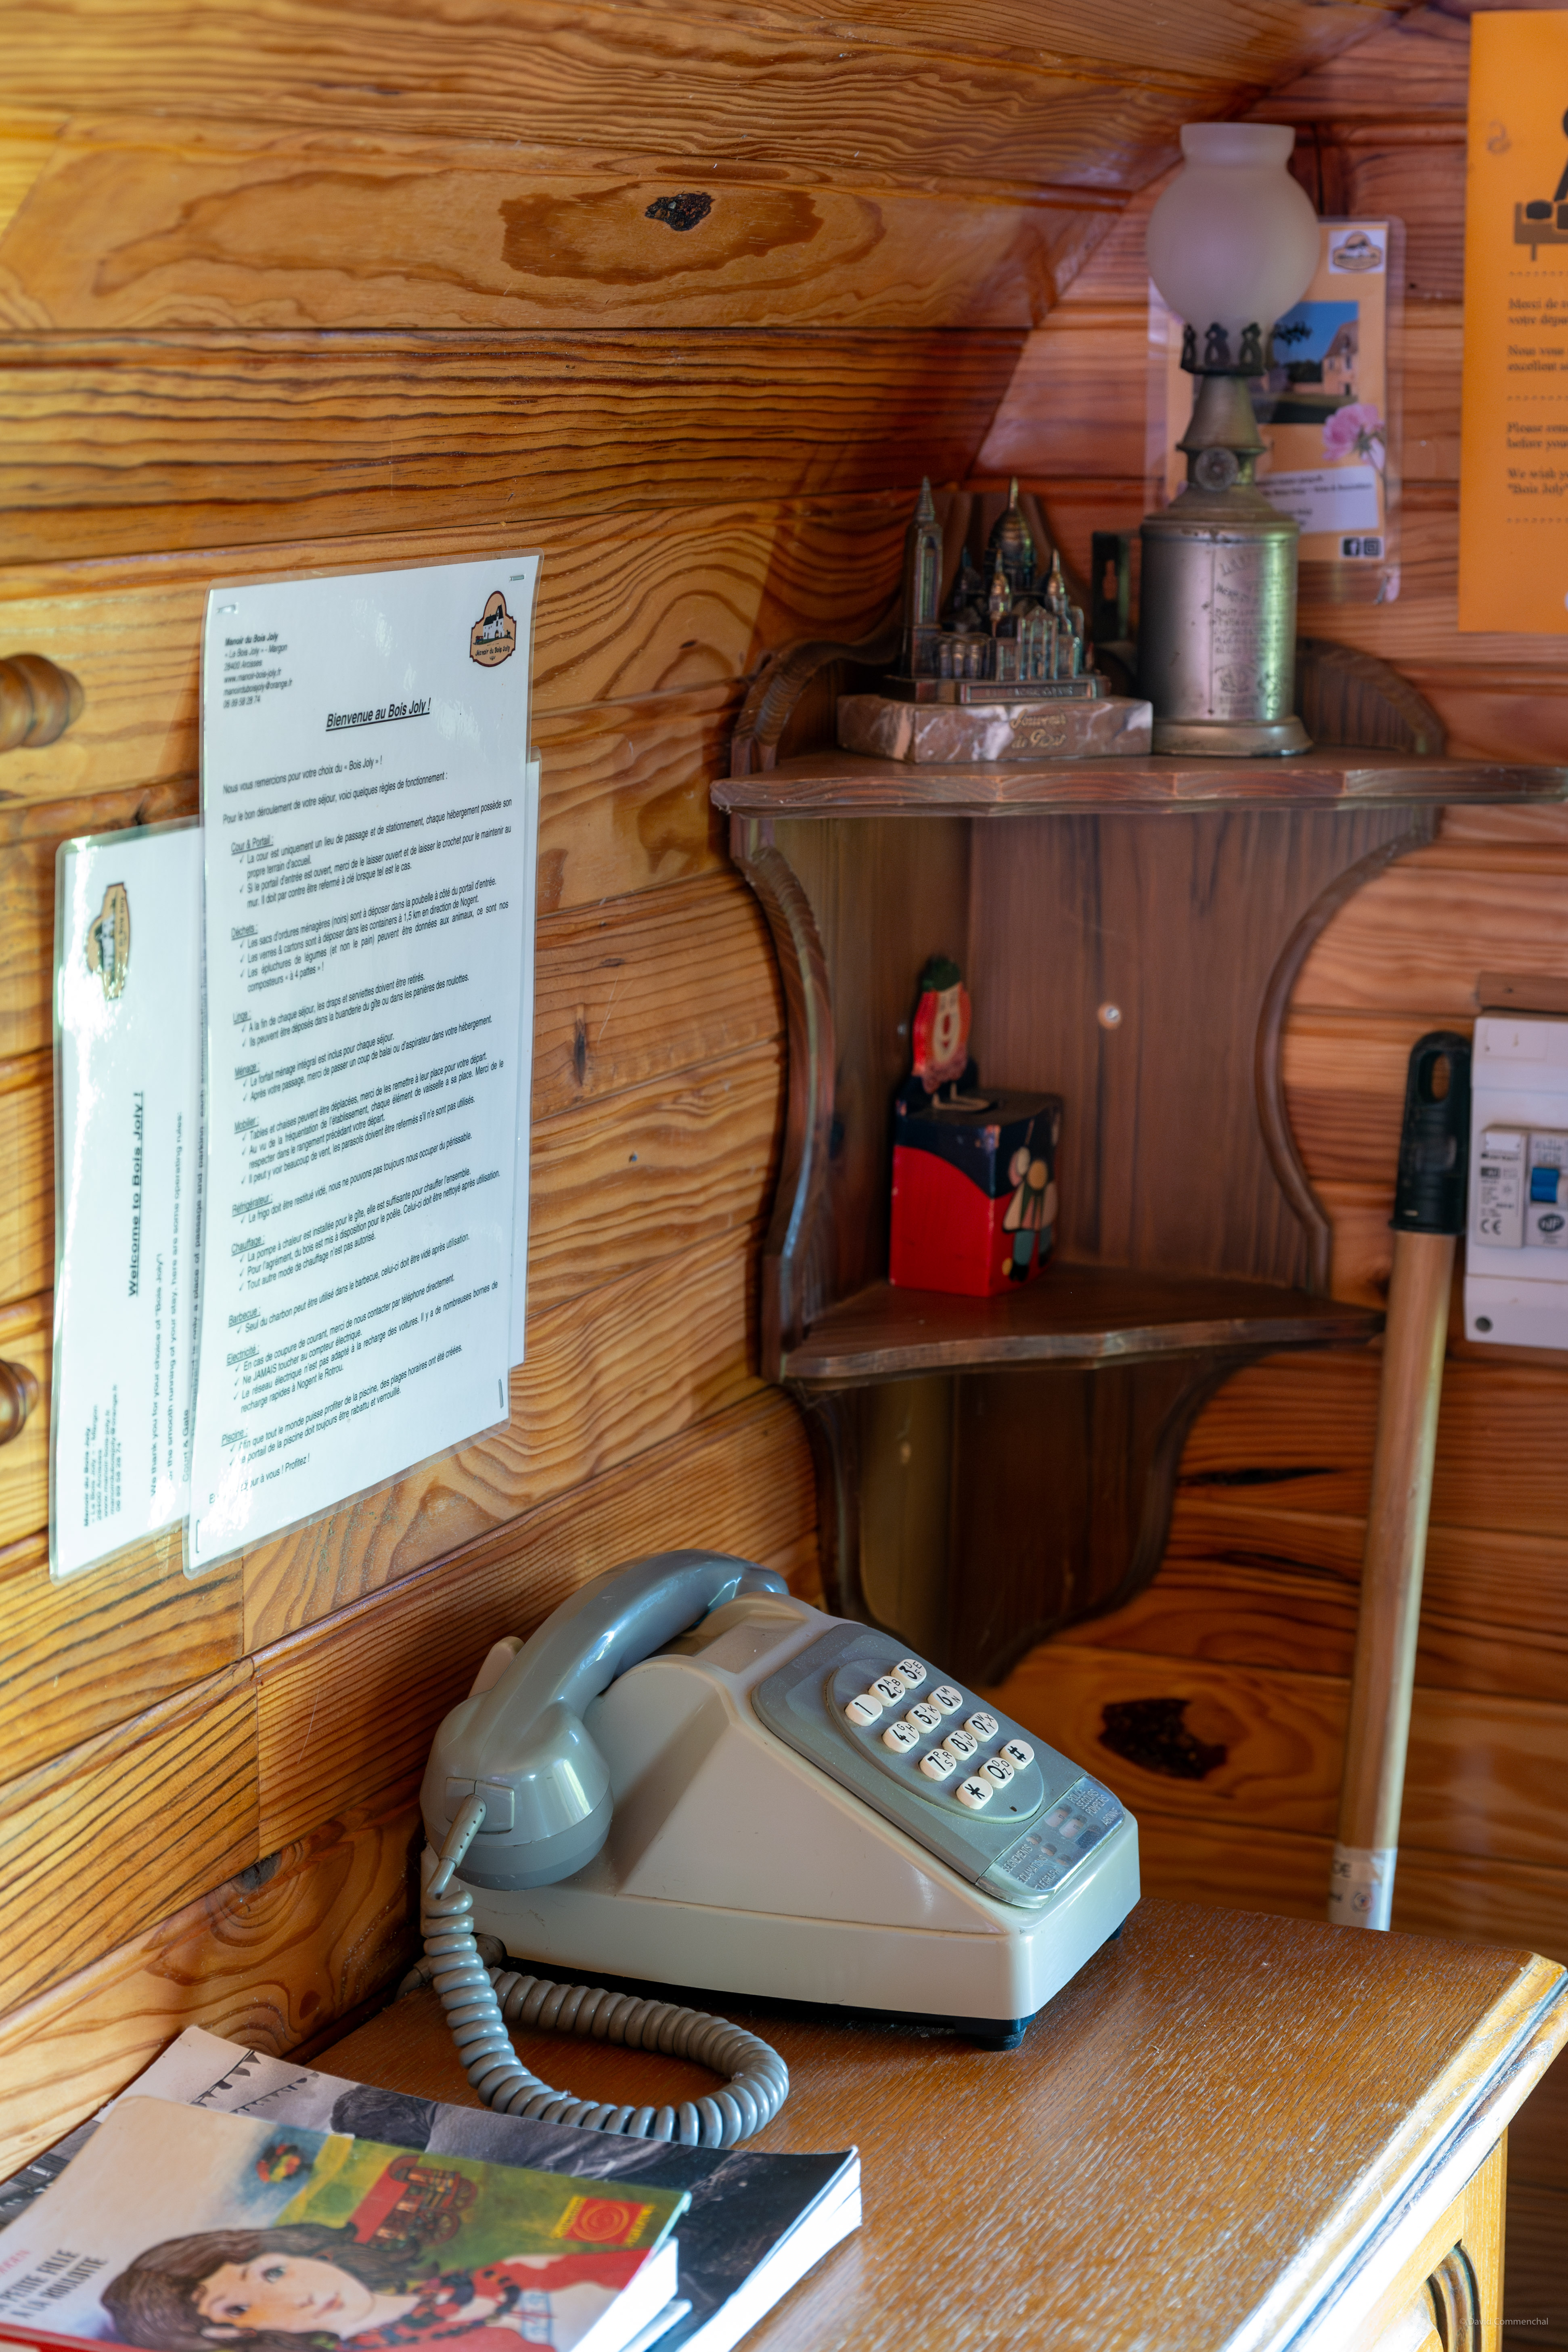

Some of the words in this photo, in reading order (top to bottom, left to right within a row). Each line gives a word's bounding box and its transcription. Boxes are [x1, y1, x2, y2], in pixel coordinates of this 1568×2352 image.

[225, 637, 244, 646] Manoir
[253, 634, 266, 643] Bois
[266, 632, 278, 642] Joly
[327, 710, 373, 727] Bienvenue
[375, 708, 386, 720] au
[388, 702, 407, 718] Bois
[407, 699, 427, 718] Joly
[223, 784, 238, 794] Nous
[240, 781, 253, 790] vous
[255, 775, 287, 787] remercions
[288, 772, 301, 783] pour
[302, 769, 317, 779] votre
[318, 765, 333, 776] choix
[335, 763, 342, 773] du
[349, 760, 362, 770] Bois
[362, 758, 374, 769] Joly
[223, 814, 236, 823] Pour
[238, 812, 243, 821] le
[244, 811, 255, 820] bon
[257, 802, 292, 817] déroulement
[293, 800, 301, 809] de
[302, 798, 316, 807] votre
[318, 794, 337, 806] séjour,
[339, 789, 352, 800] voici
[353, 786, 378, 800] quelques
[379, 782, 396, 794] règles
[397, 779, 404, 790] de
[405, 772, 444, 787] fonctionnement
[247, 868, 265, 879] propre
[267, 863, 285, 873] terrain
[286, 855, 311, 869] d'accueil.
[248, 954, 258, 963] Les
[260, 949, 276, 959] verres
[284, 941, 304, 953] cartons
[305, 936, 316, 947] sont
[322, 930, 344, 943] déposer
[345, 926, 359, 936] dans
[360, 924, 368, 932] les
[369, 917, 397, 930] containers
[404, 911, 412, 922] 1,5
[413, 910, 421, 919] km
[422, 909, 429, 917] en
[430, 902, 452, 915] direction
[452, 899, 459, 909] de
[460, 894, 479, 907] Nogent.
[133, 1104, 142, 1141] Joly
[132, 1148, 140, 1186] Bois
[248, 1208, 257, 1223] Le
[257, 1204, 270, 1220] frigo
[271, 1202, 281, 1214] doit
[283, 1200, 293, 1210] être
[294, 1190, 314, 1205] restitué
[315, 1185, 327, 1197] vidé,
[329, 1181, 341, 1192] nous
[342, 1178, 349, 1187] ne
[350, 1170, 372, 1186] pouvons
[373, 1166, 383, 1177] pas
[384, 1158, 404, 1171] toujours
[406, 1153, 418, 1163] nous
[419, 1145, 438, 1158] occuper
[439, 1141, 445, 1150] du
[446, 1132, 472, 1150] périssable.
[132, 1193, 139, 1209] to
[128, 1217, 139, 1296] Welcome
[228, 1309, 257, 1326] Barbecue
[243, 1376, 251, 1384] Ne
[253, 1363, 276, 1381] JAMAIS
[278, 1356, 299, 1371] toucher
[300, 1353, 308, 1361] au
[309, 1341, 334, 1357] compteur
[335, 1330, 362, 1346] électrique.
[241, 1397, 268, 1412] recharge
[269, 1387, 290, 1401] rapides
[297, 1374, 317, 1390] Nogent
[318, 1372, 323, 1381] le
[324, 1364, 343, 1378] Rotrou.
[898, 1665, 917, 1680] 3
[877, 1684, 897, 1699] 2
[936, 1693, 953, 1707] 6
[854, 1702, 873, 1715] 1
[913, 1710, 932, 1724] 5
[892, 1729, 910, 1743] 4
[971, 1720, 989, 1734] 9
[950, 1738, 969, 1752] 8
[1007, 1746, 1026, 1762] #
[927, 1756, 946, 1771] 7
[987, 1765, 1005, 1780] 0
[1067, 1787, 1086, 1803] POLICE
[1076, 1789, 1099, 1809] SECOURS
[1085, 1795, 1110, 1816] POMPIERS
[1003, 1844, 1033, 1873] SEIGNEMENTS
[1017, 1855, 1048, 1884] ECLAMATIONS
[36, 2249, 80, 2275] FILLE
[38, 2257, 108, 2300] ROULOTTE
